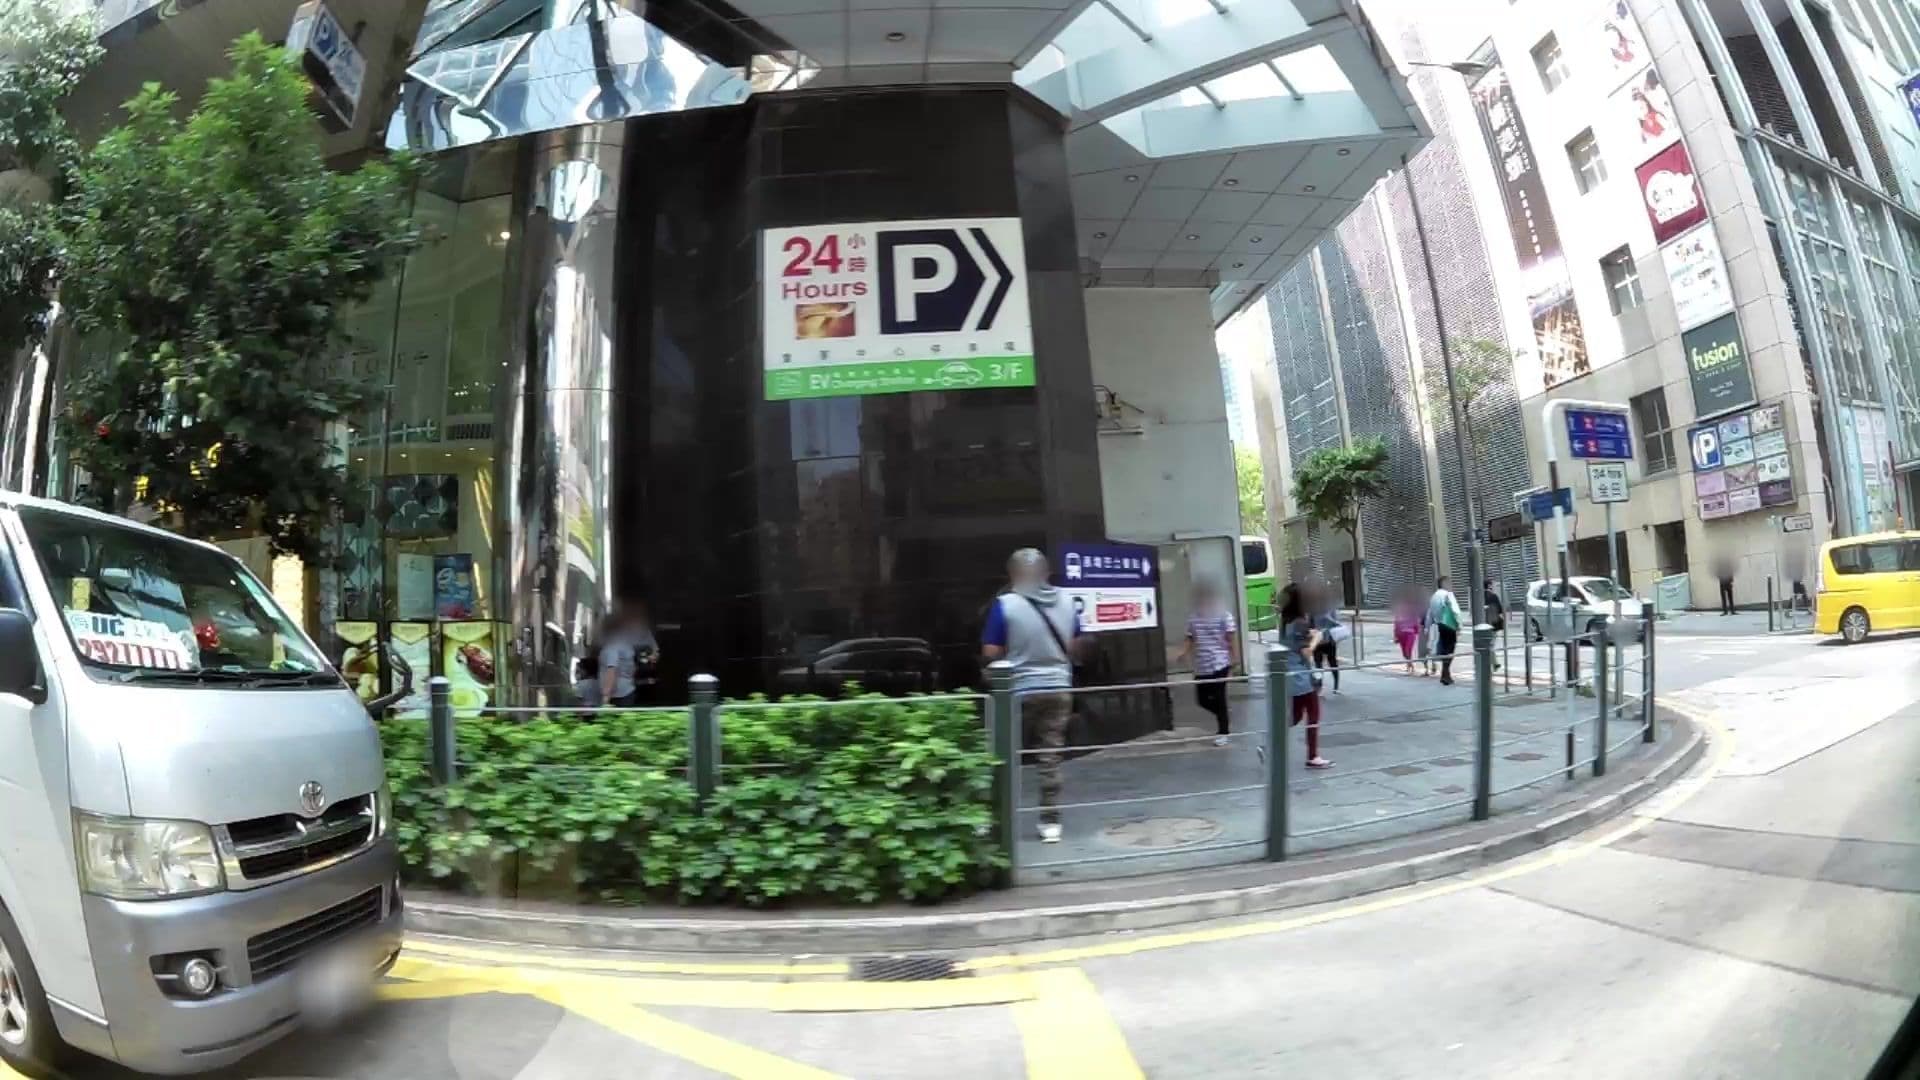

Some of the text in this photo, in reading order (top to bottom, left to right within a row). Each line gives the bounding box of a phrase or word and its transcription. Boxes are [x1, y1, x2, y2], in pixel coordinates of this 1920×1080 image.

[782, 235, 843, 277] 24
[782, 280, 868, 300] Hours
[892, 243, 958, 323] P
[1692, 341, 1740, 371] fusion
[988, 363, 1023, 381] 3/F
[1699, 432, 1716, 466] P
[91, 616, 124, 637] UC
